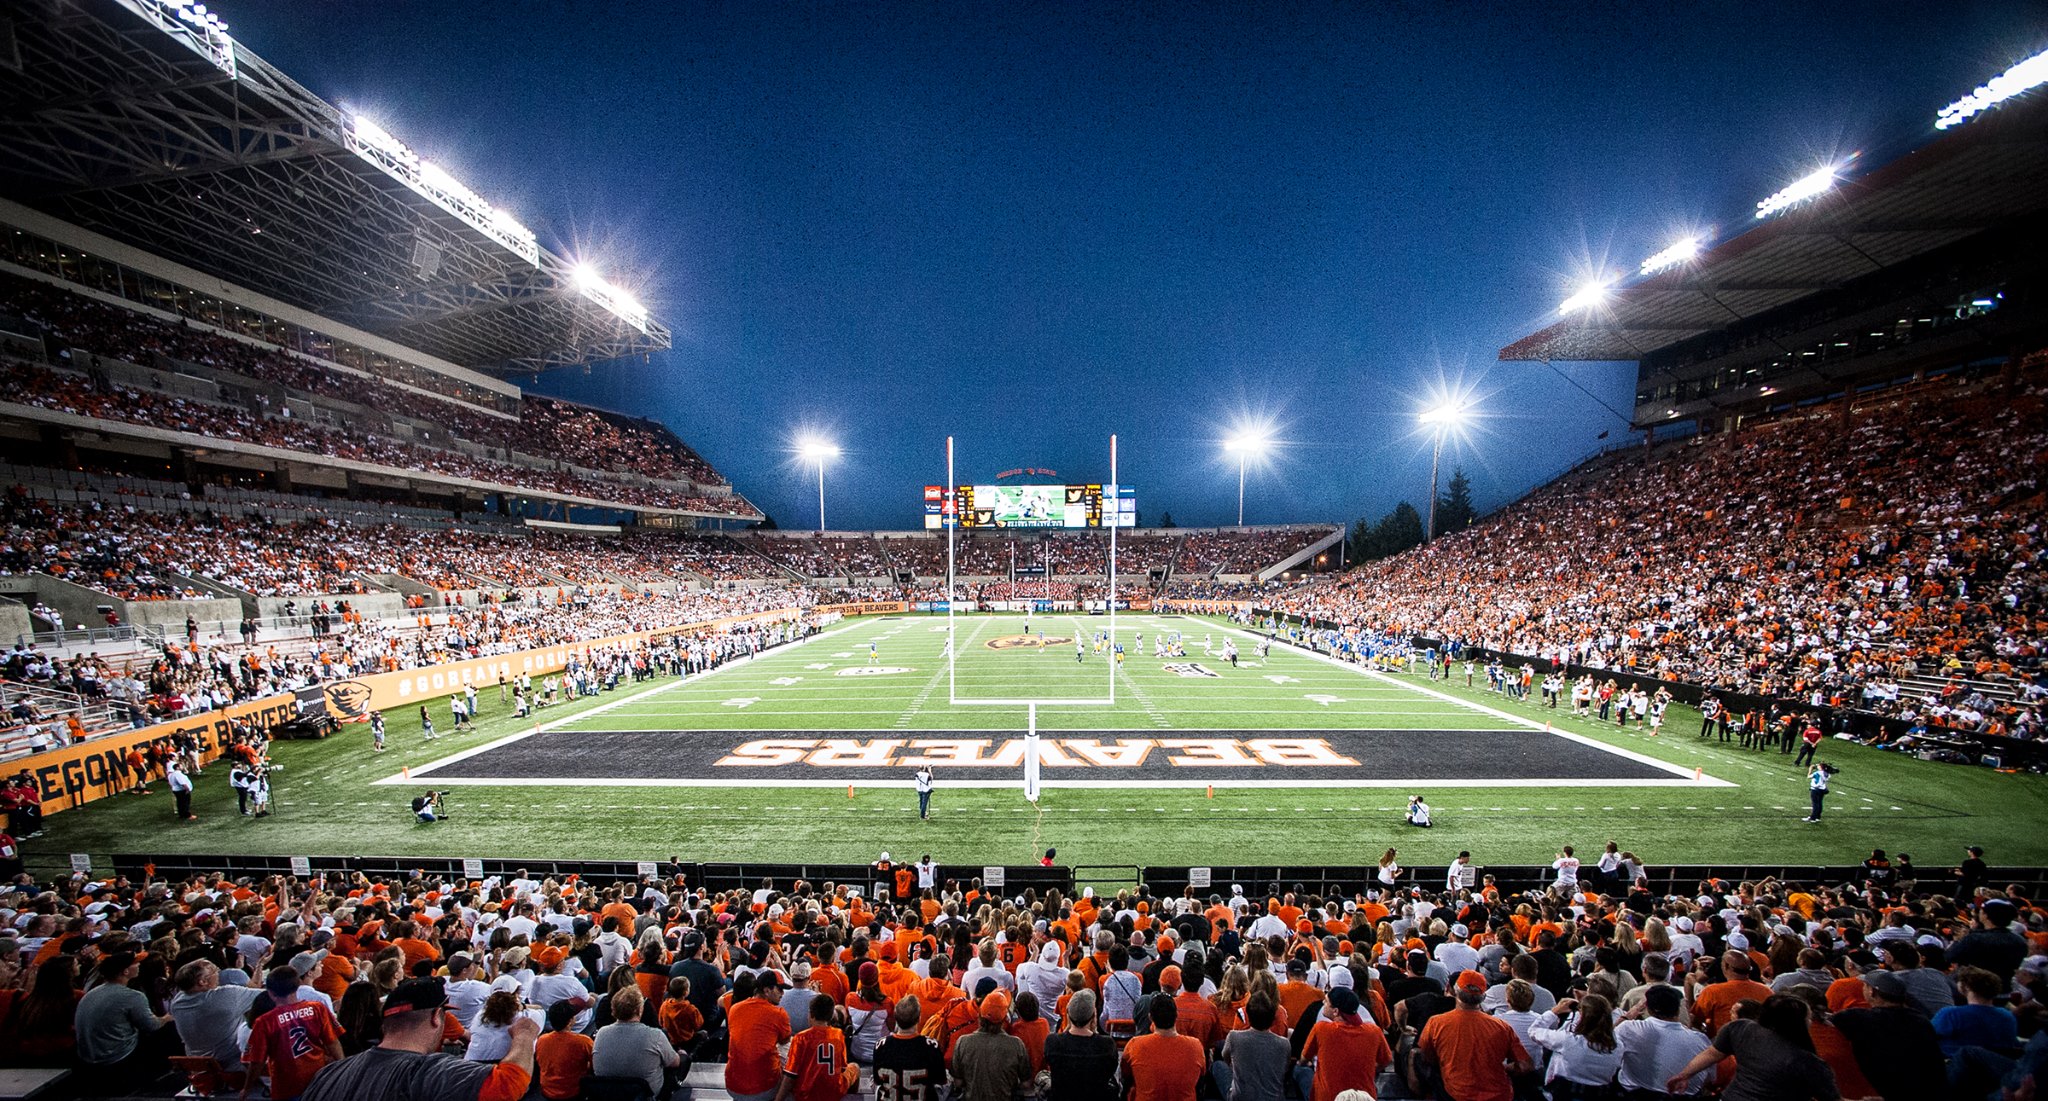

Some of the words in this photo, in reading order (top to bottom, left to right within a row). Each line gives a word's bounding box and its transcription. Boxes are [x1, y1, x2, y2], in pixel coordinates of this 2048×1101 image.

[864, 603, 898, 612] BEAVERS
[399, 661, 510, 697] #GOBEAVS
[1003, 946, 1014, 963] 6
[289, 1026, 314, 1059] 2
[817, 1042, 835, 1076] 4
[877, 1067, 929, 1101] 35
